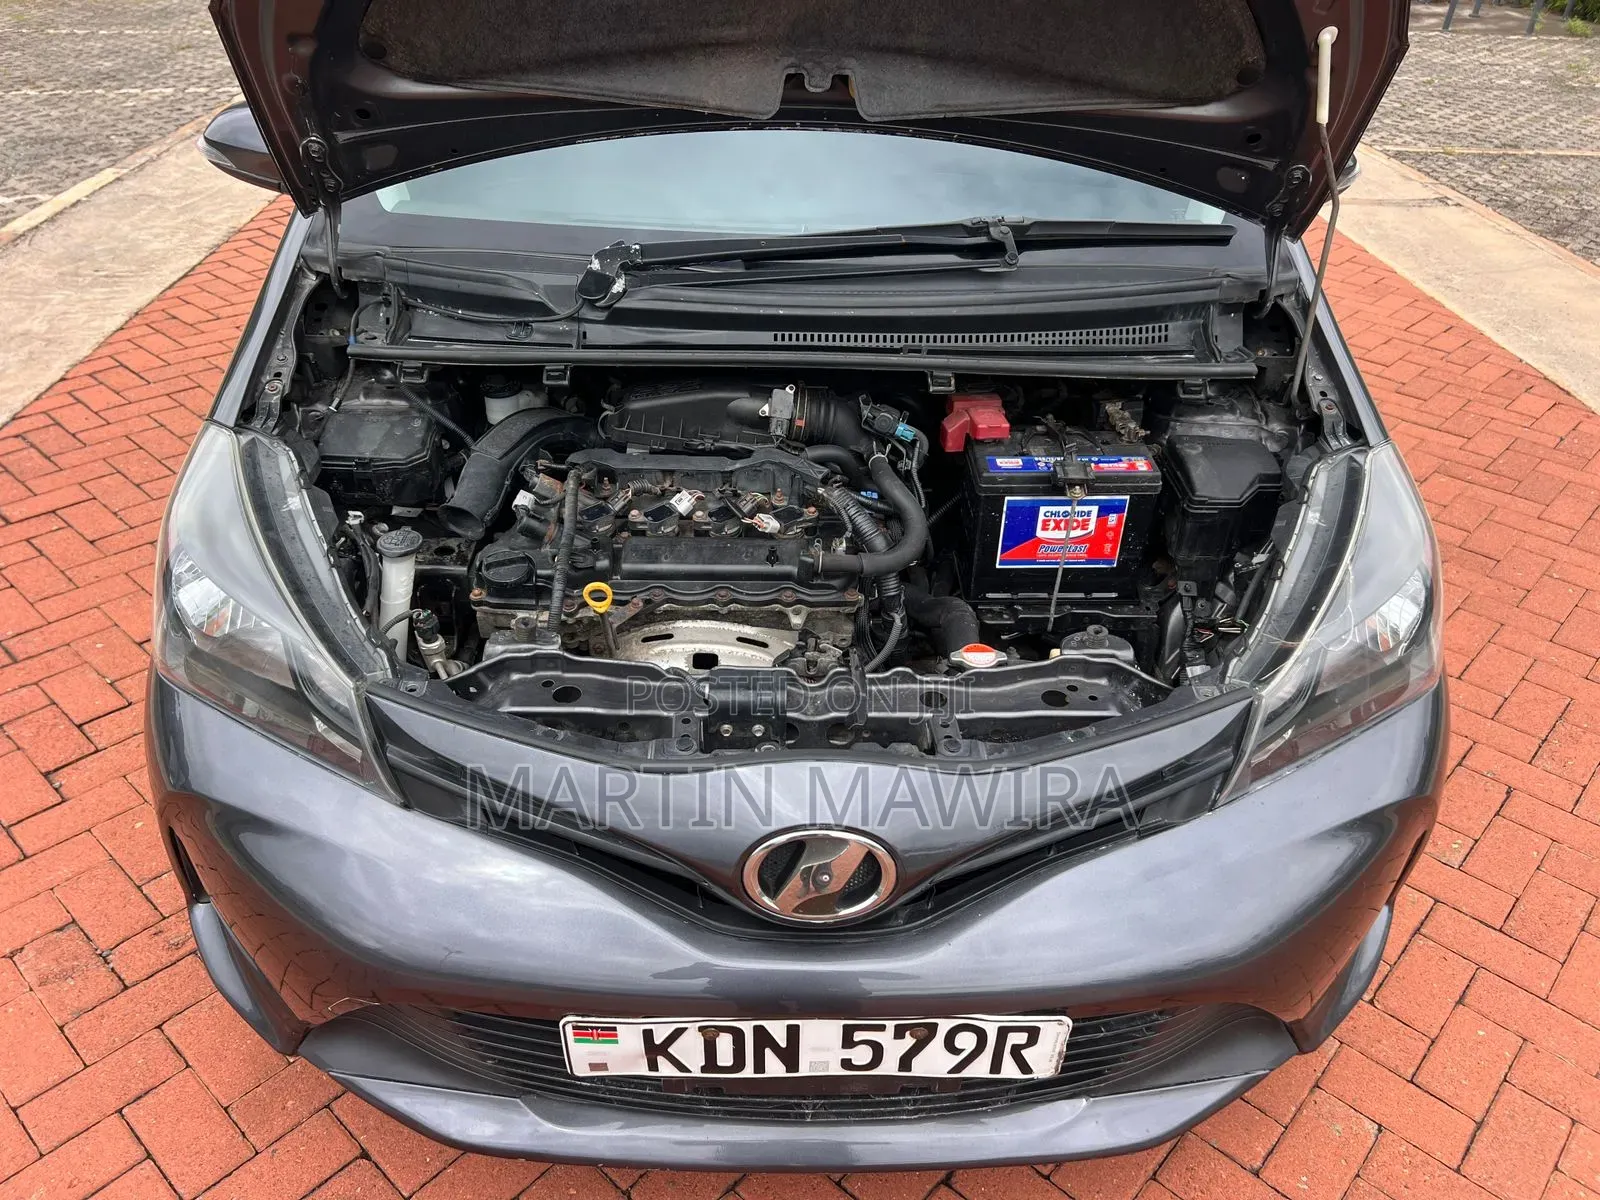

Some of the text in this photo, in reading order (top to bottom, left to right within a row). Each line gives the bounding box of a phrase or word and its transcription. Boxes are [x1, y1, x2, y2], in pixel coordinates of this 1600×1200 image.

[1041, 518, 1091, 531] EXIDE
[1038, 544, 1088, 553] PoweLast
[642, 1024, 801, 1074] KDN
[840, 1022, 1042, 1075] 579R
